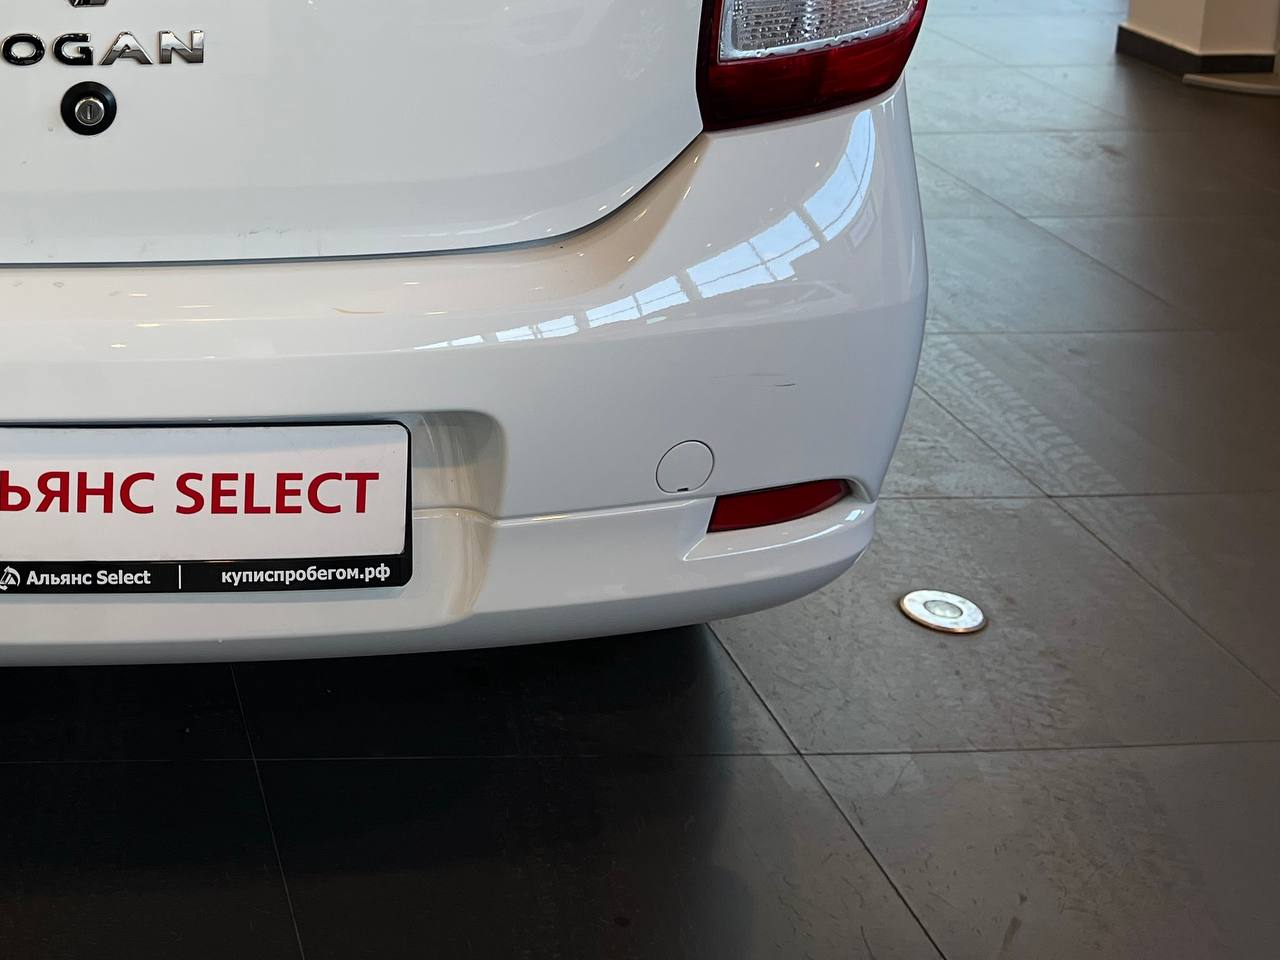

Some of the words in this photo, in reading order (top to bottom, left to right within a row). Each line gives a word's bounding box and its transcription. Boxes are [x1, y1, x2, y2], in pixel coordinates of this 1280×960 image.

[175, 471, 380, 515] SELECT
[26, 570, 91, 586] Альянс
[96, 568, 151, 585] Select
[221, 563, 391, 585] куписпробегом.рф
